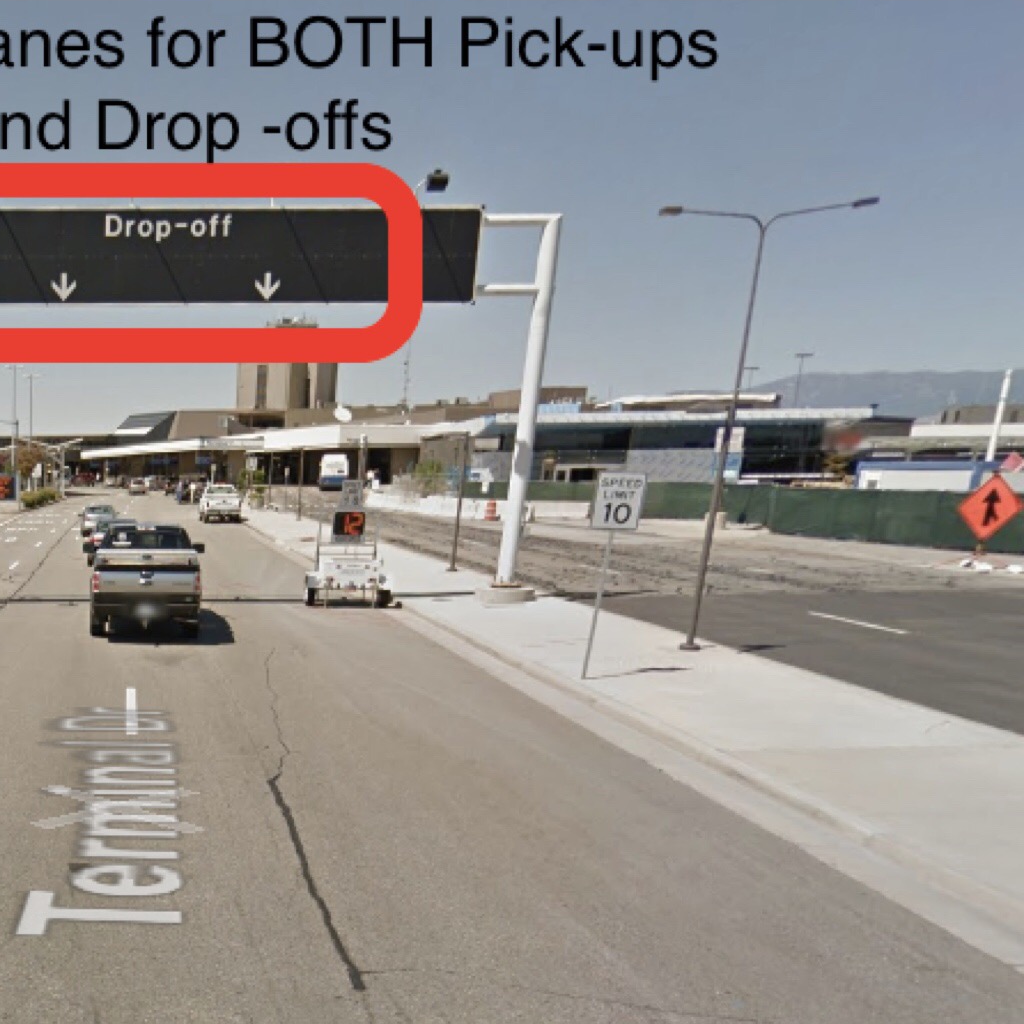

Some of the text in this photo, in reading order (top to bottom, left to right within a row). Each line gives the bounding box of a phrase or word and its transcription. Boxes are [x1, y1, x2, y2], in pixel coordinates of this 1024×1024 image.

[105, 212, 233, 243] Drop-off
[601, 477, 644, 488] SPEED
[603, 490, 636, 500] LIMIT
[603, 502, 633, 525] 10
